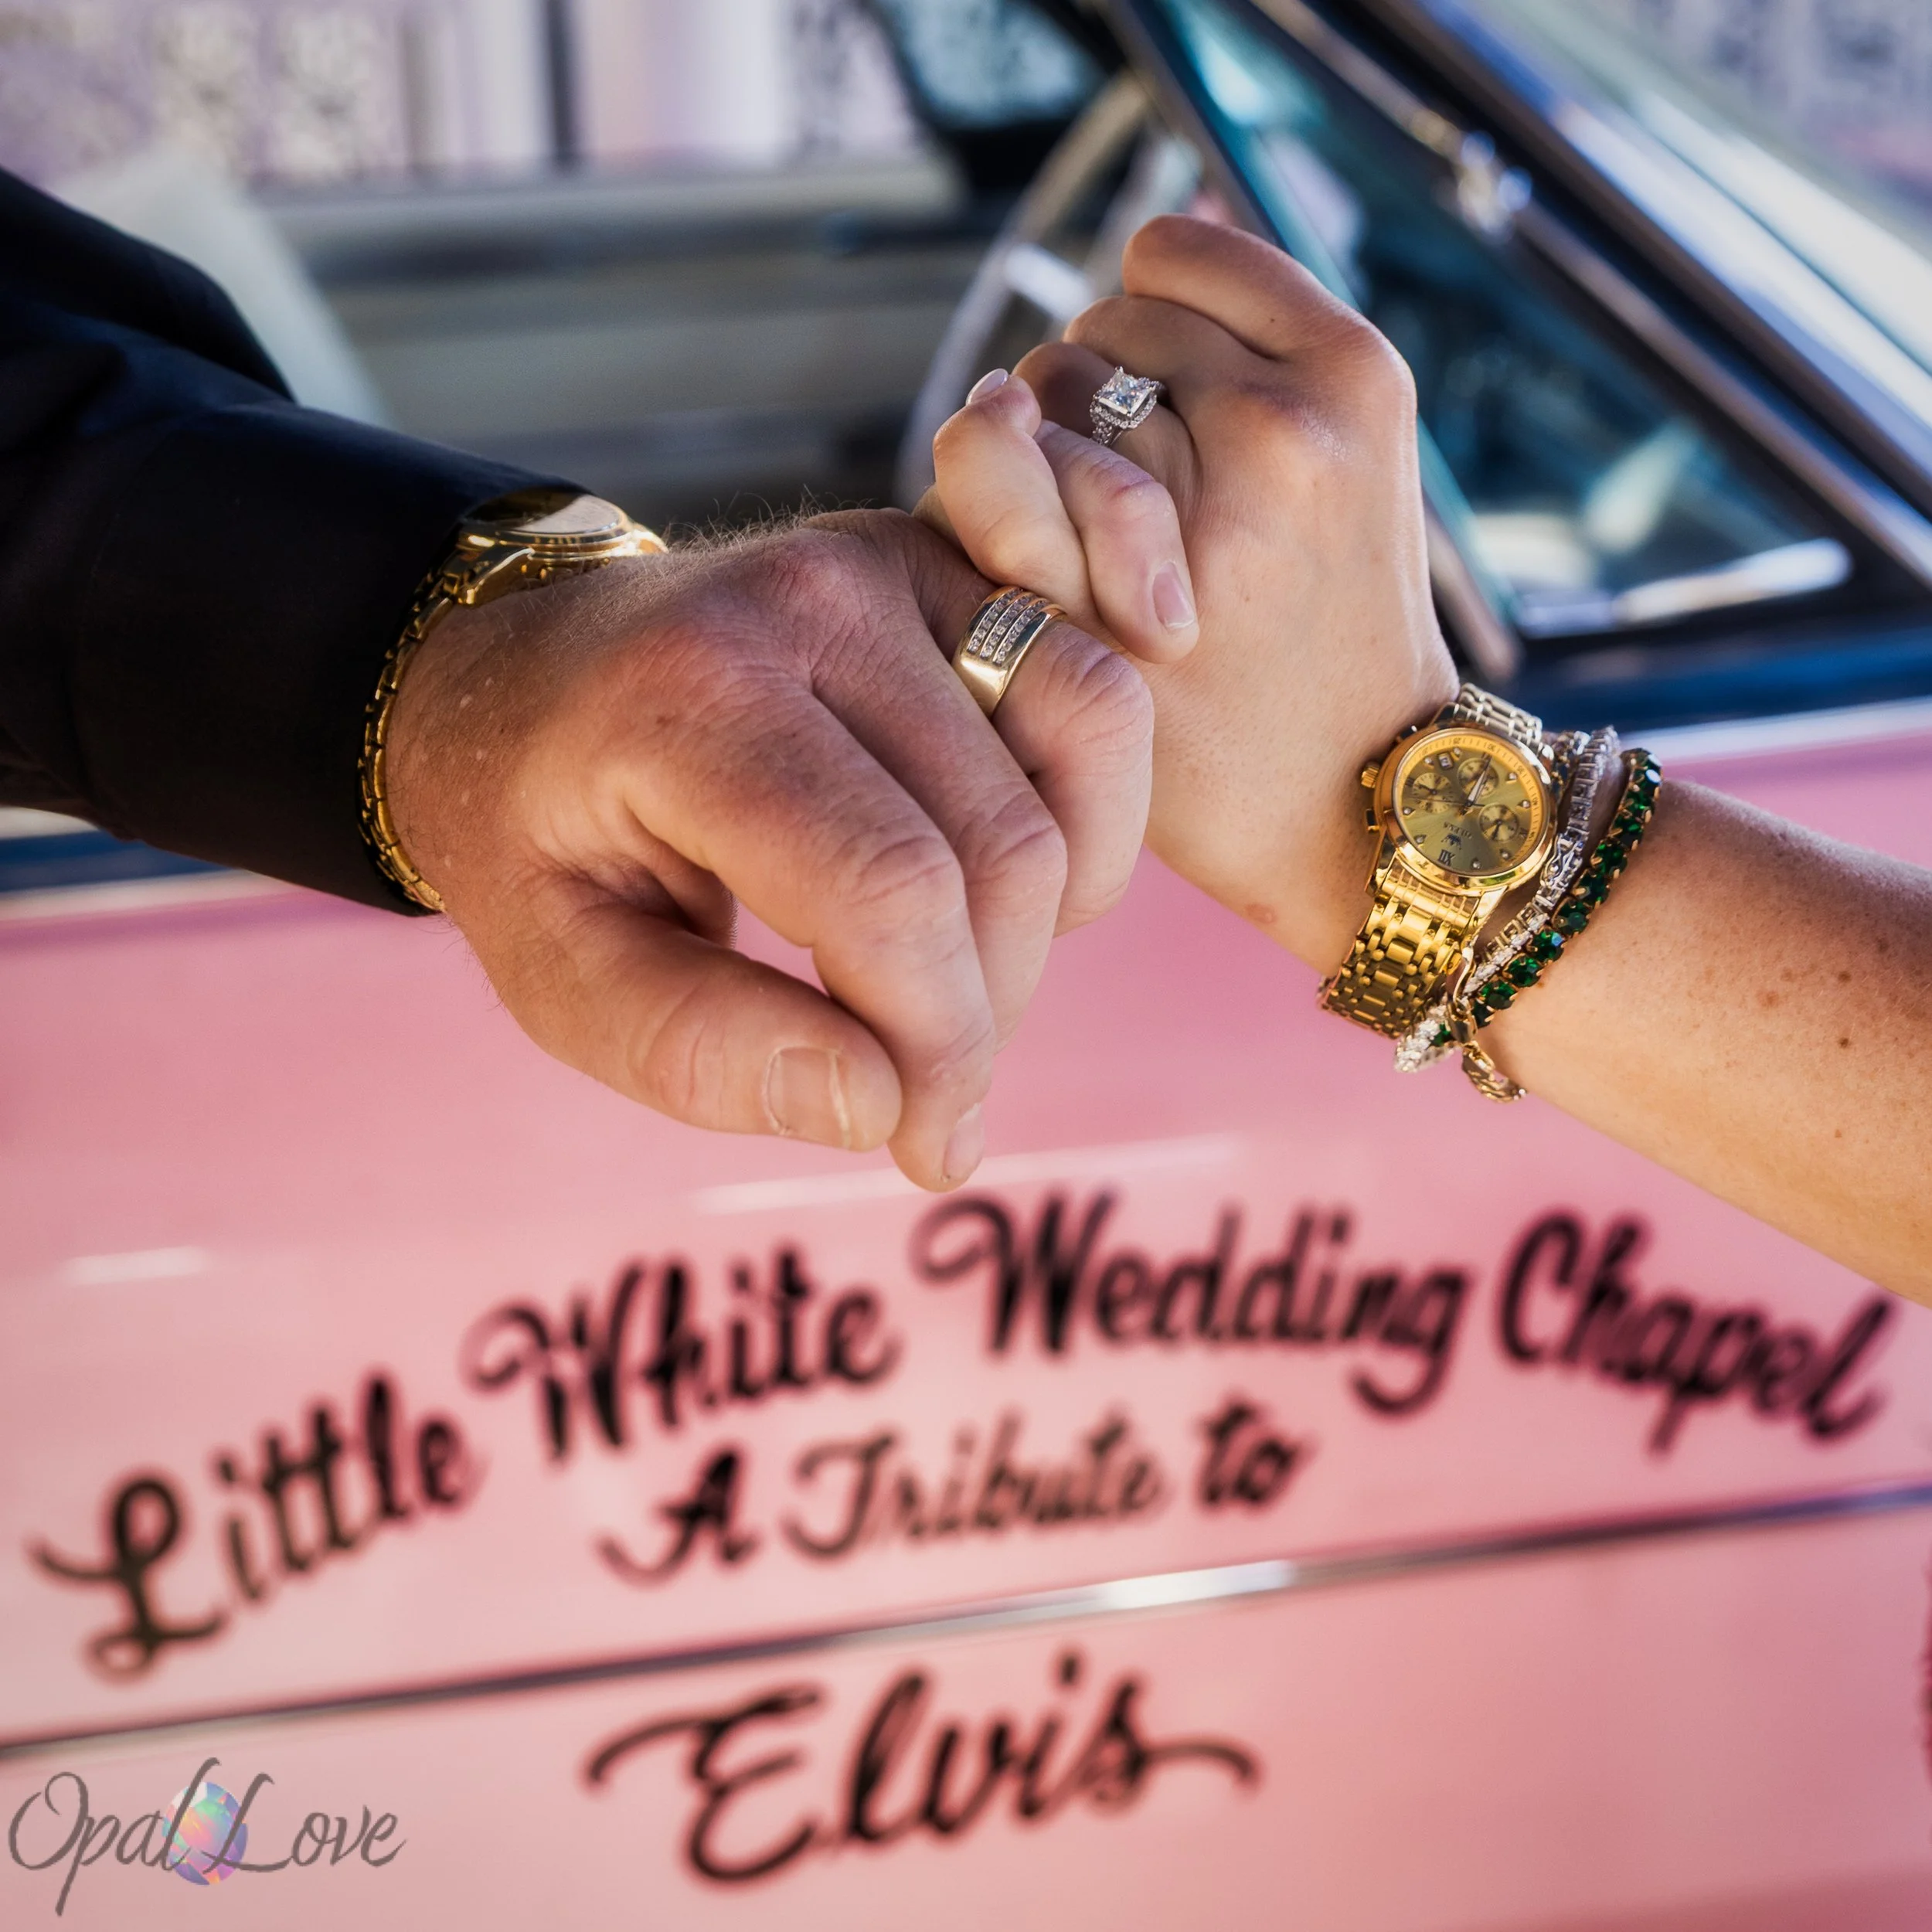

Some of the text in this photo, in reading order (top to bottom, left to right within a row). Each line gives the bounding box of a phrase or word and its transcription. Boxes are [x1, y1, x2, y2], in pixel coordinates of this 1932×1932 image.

[1437, 849, 1456, 866] XII
[26, 1186, 1898, 1682] Little White Wedding Chapel
[594, 1391, 1312, 1586] A Tribute to
[580, 1645, 1264, 1889] Elvis
